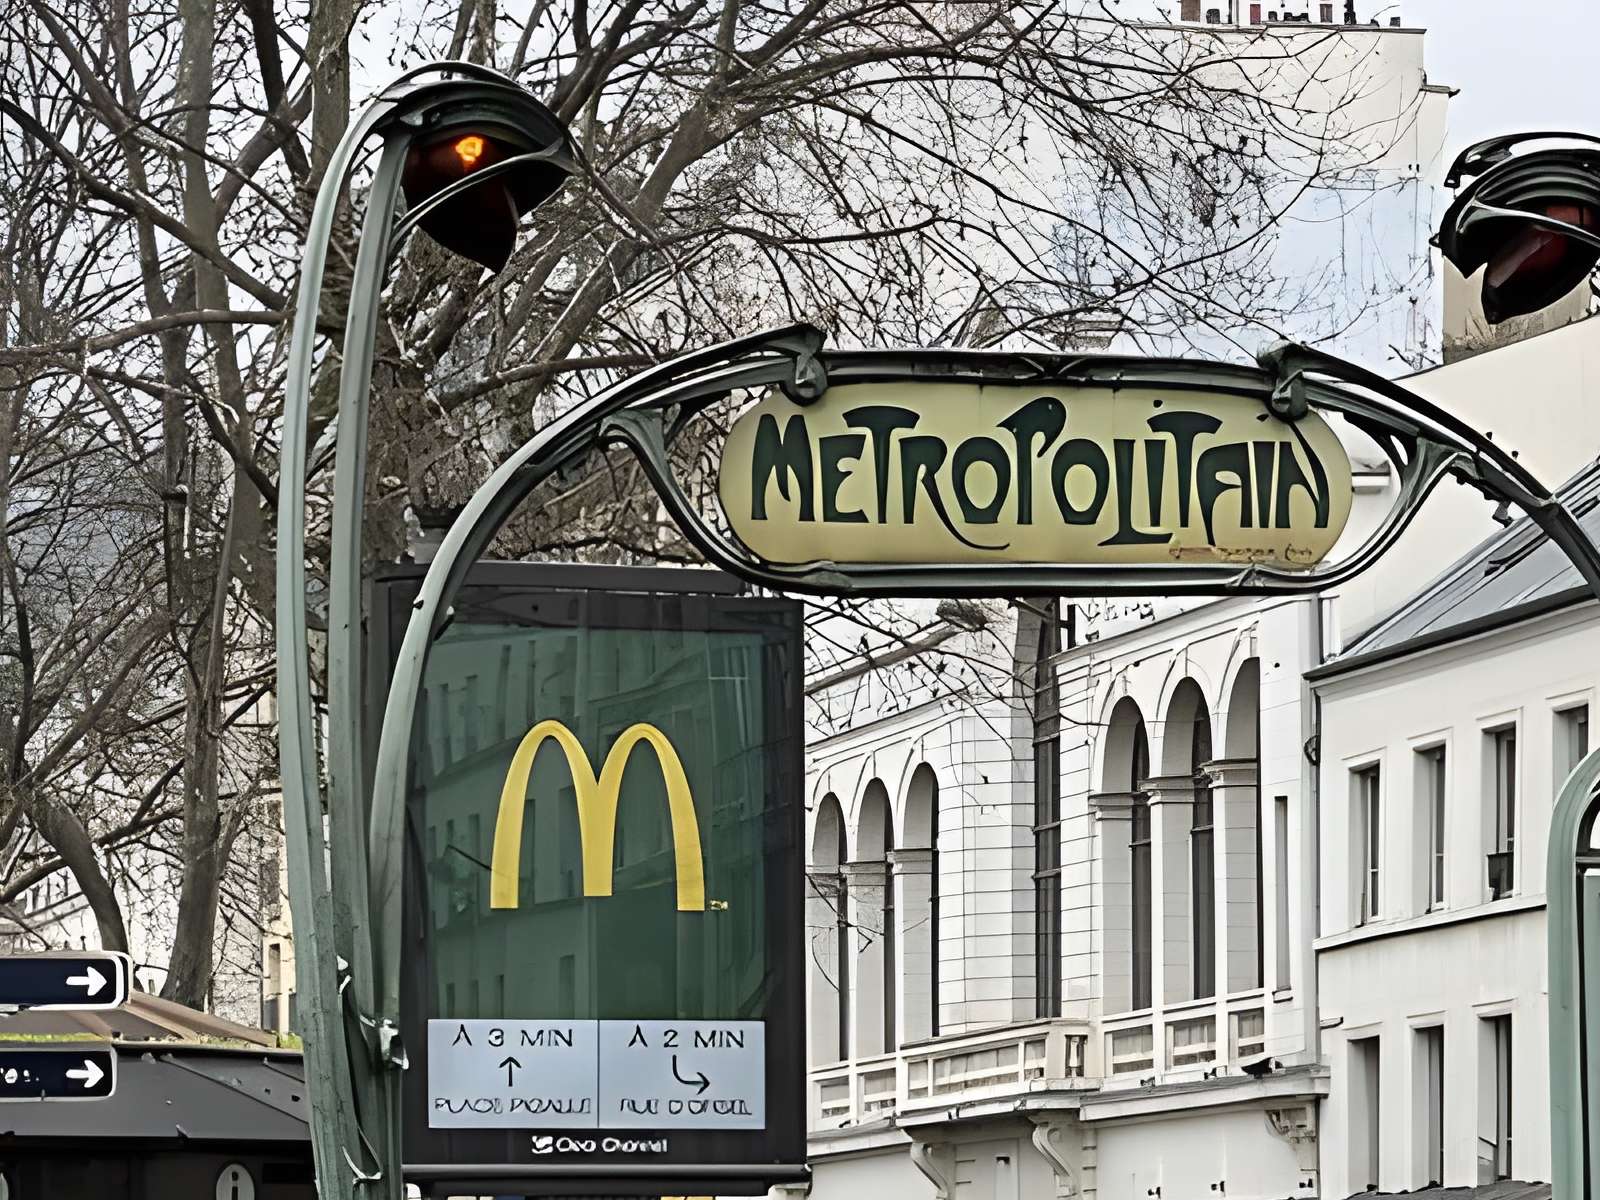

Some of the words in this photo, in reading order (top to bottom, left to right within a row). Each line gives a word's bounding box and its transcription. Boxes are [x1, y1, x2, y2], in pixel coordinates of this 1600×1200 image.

[750, 397, 1328, 551] METROPOLITAIN
[488, 1029, 505, 1048] 3
[520, 1029, 573, 1048] MIN
[663, 1029, 679, 1048] 2
[694, 1030, 745, 1049] MIN
